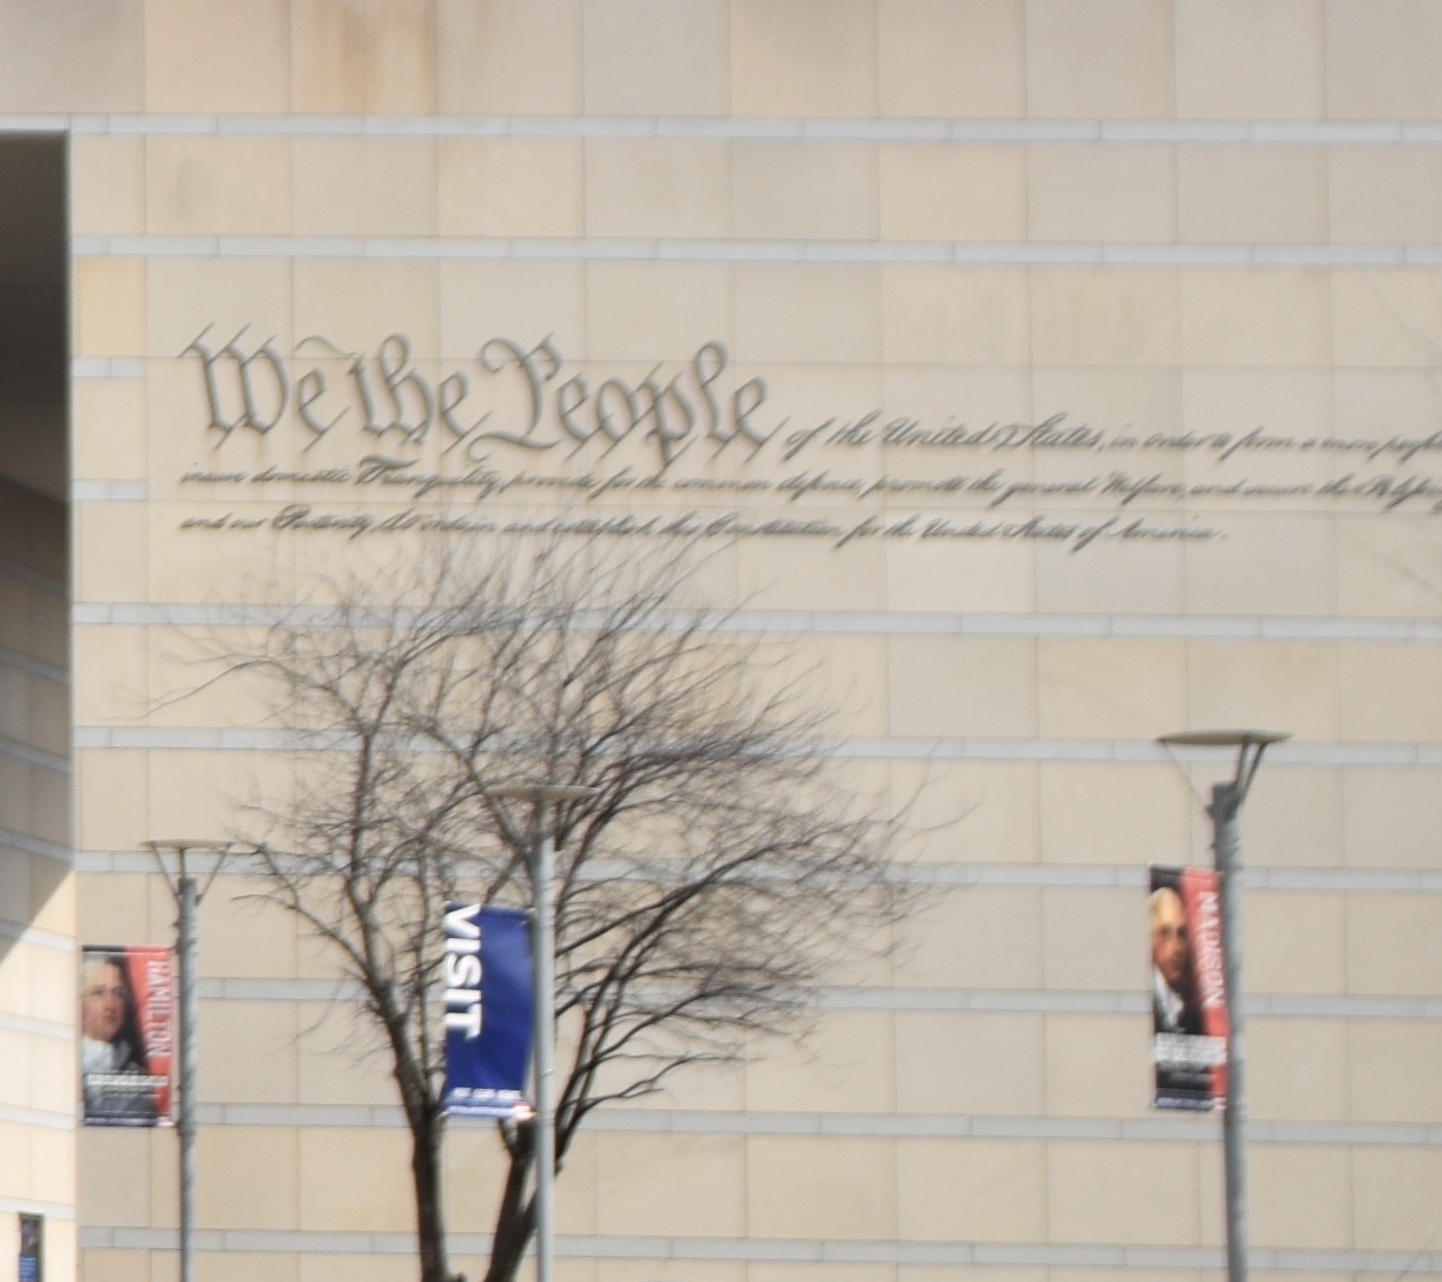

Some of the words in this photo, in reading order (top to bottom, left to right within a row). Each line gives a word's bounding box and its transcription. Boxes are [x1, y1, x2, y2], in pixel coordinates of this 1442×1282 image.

[178, 321, 351, 454] We
[348, 331, 493, 454] the
[472, 332, 789, 474] People
[145, 959, 172, 1058] HAMILTON
[444, 903, 483, 1040] VISIT
